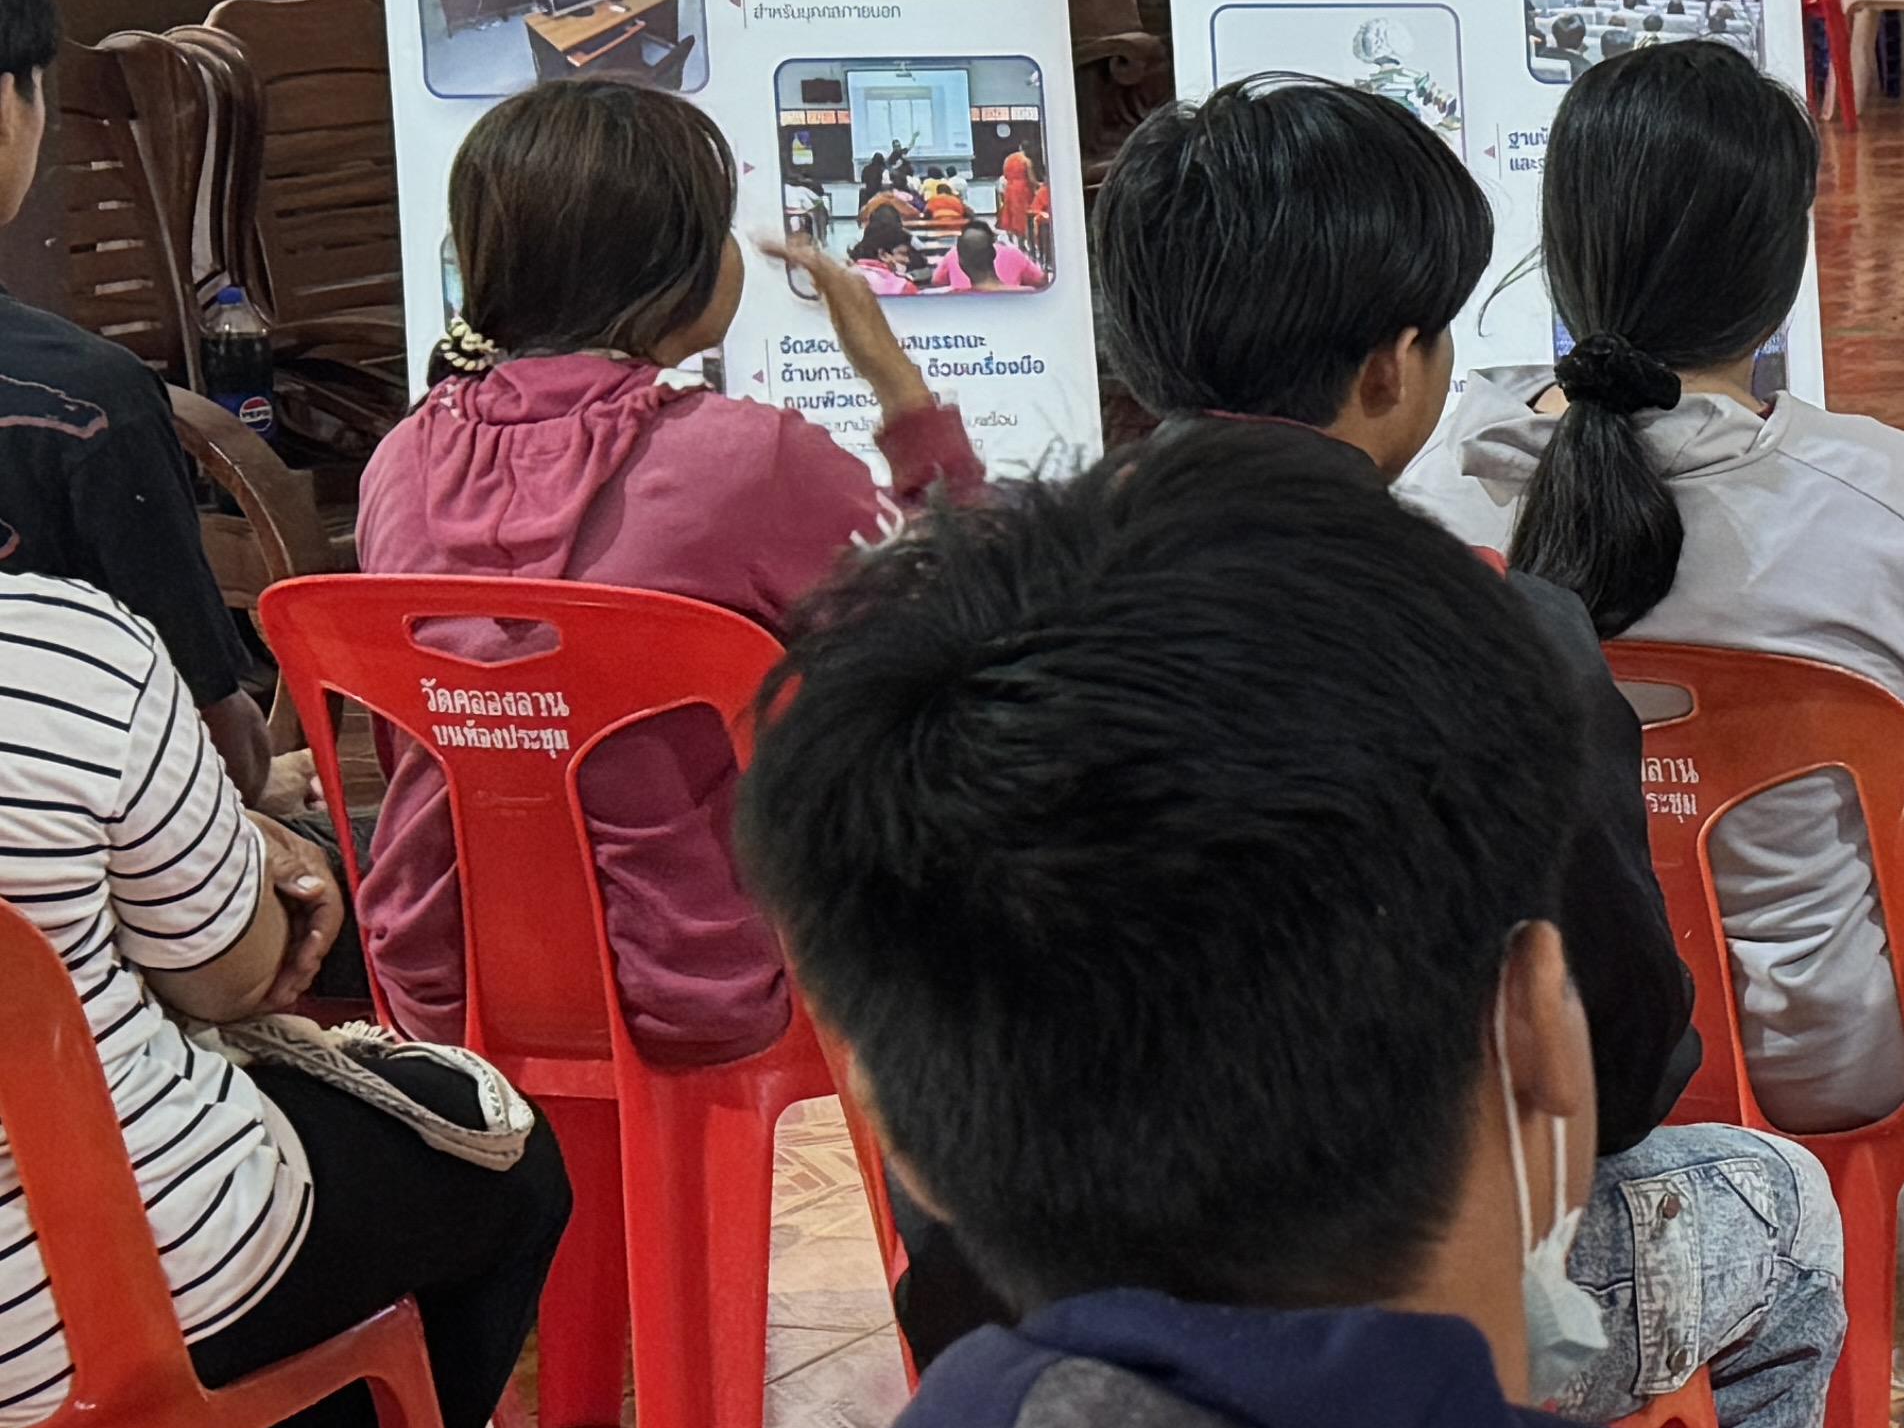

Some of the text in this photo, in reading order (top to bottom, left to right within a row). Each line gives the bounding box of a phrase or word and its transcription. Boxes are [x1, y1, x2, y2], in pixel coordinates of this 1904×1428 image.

[420, 678, 570, 717] วัดคลองลาน
[432, 720, 570, 759] บนห้องประชุม
